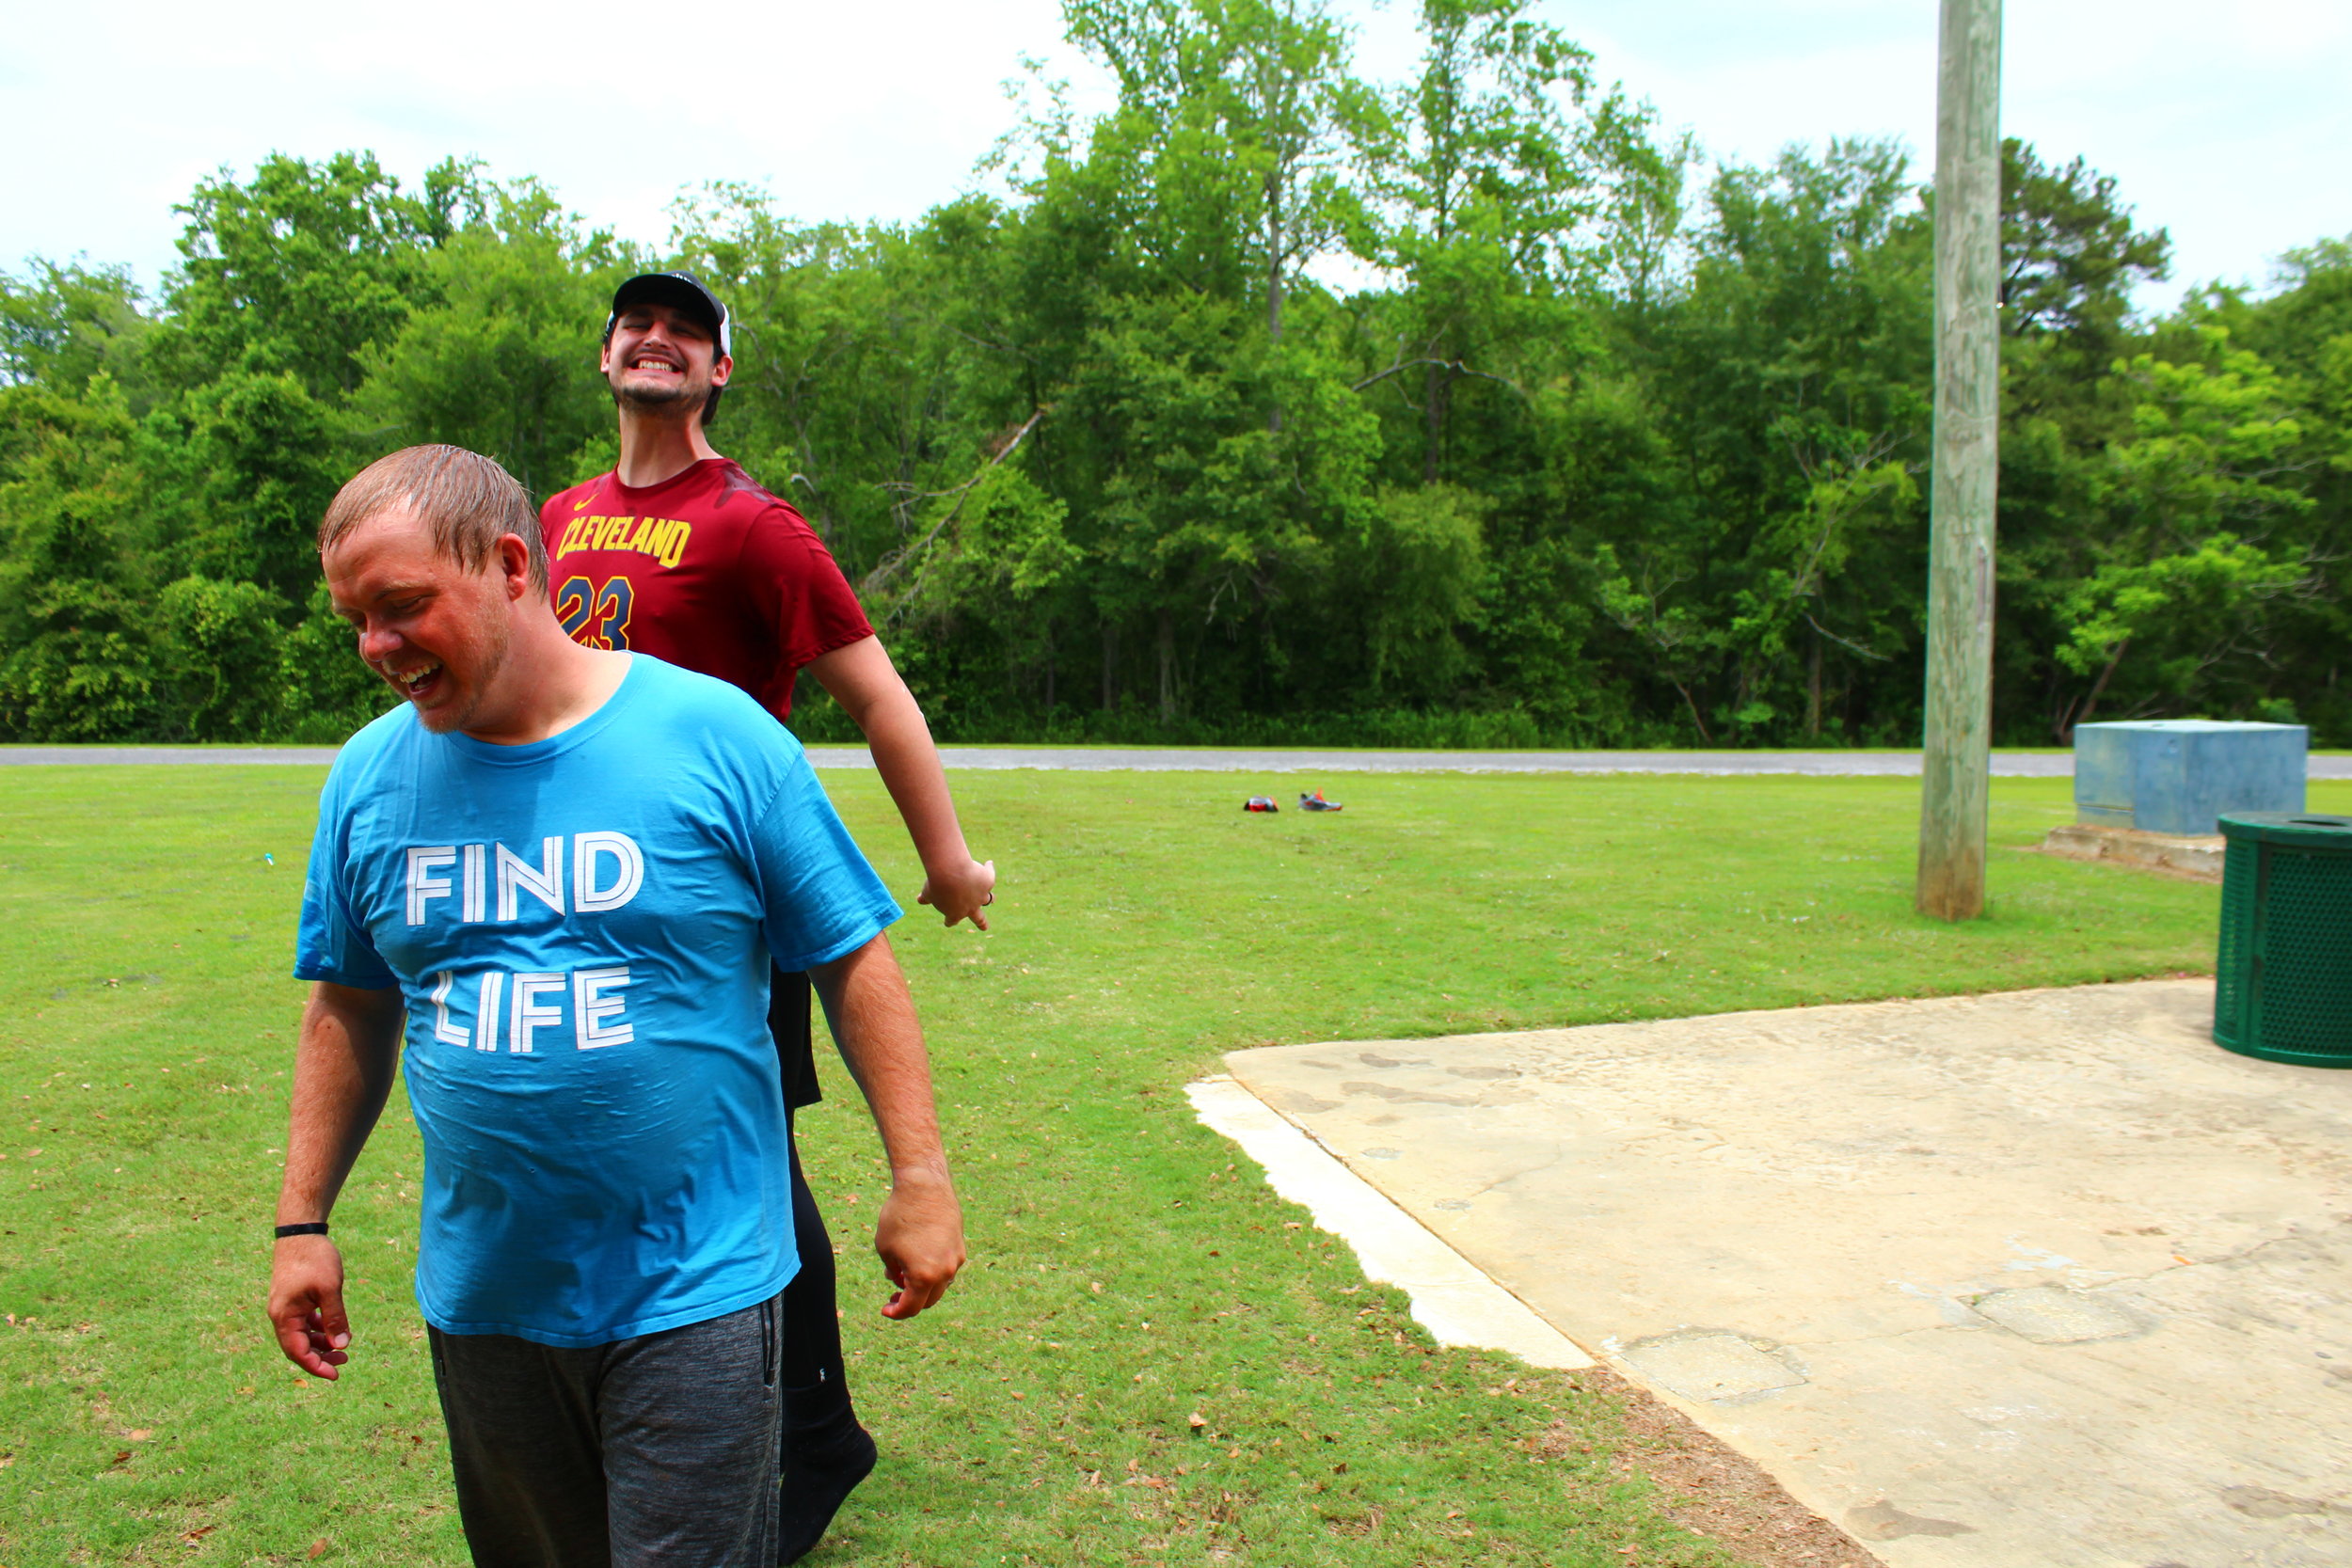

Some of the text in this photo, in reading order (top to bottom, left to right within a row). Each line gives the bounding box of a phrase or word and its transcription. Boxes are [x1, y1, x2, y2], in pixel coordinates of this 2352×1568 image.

[556, 515, 691, 569] CLEVELAND
[556, 576, 634, 650] 23
[406, 831, 644, 926] FIND
[431, 966, 635, 1053] LIFE
